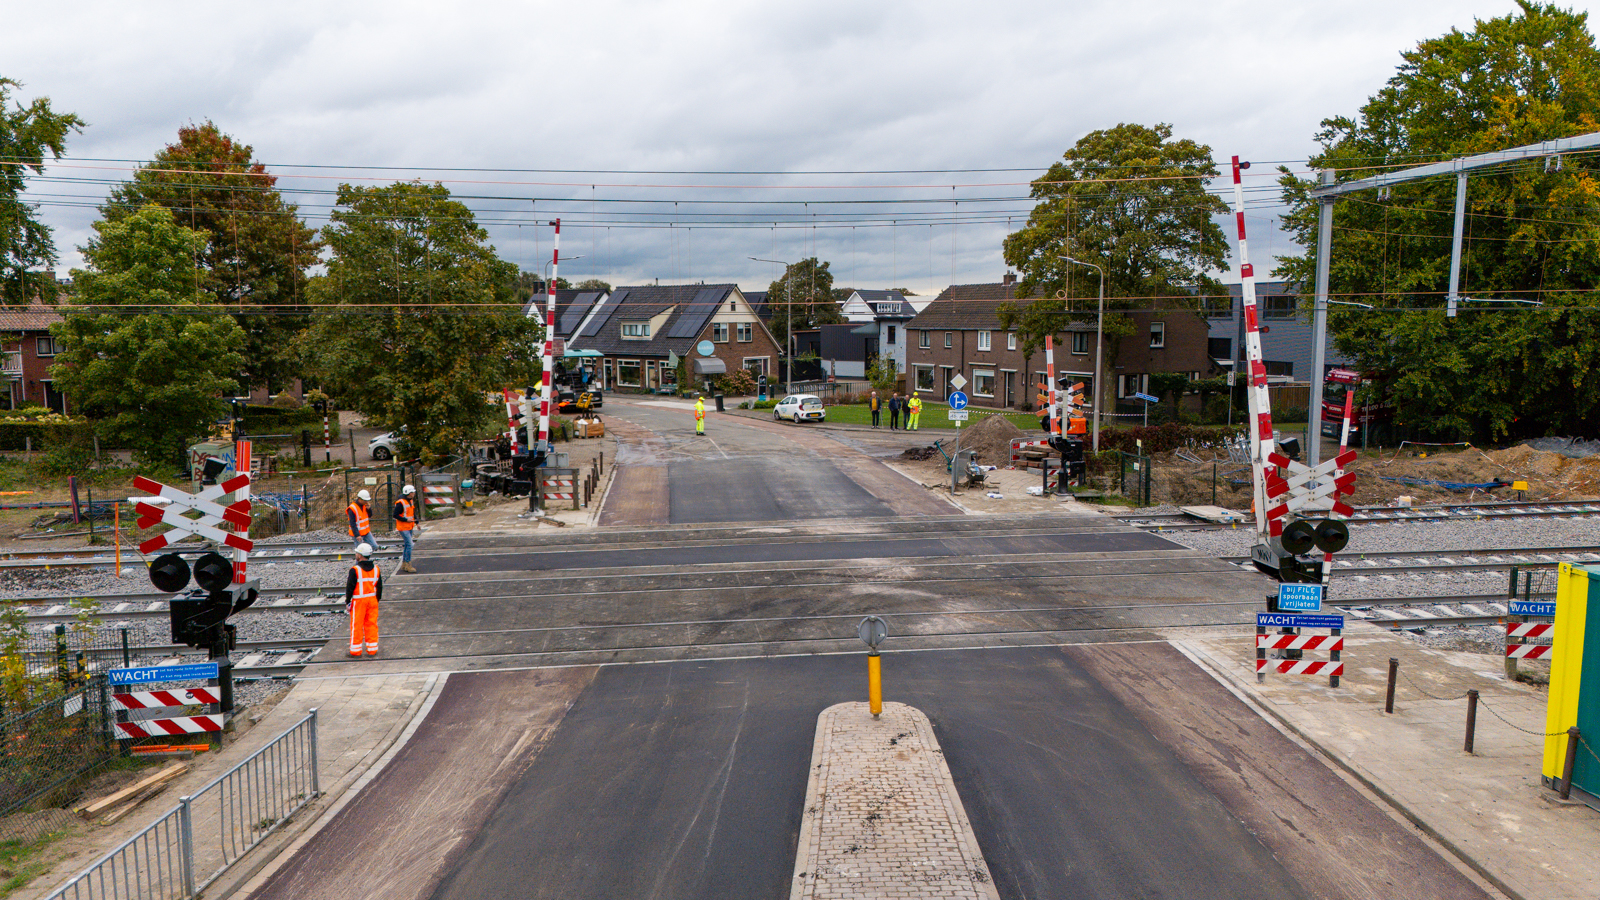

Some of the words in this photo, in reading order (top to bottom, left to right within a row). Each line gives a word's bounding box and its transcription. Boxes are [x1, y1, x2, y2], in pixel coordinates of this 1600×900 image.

[1510, 604, 1552, 613] WACHT
[1259, 616, 1296, 624] WACHT
[112, 670, 158, 682] WACHT
